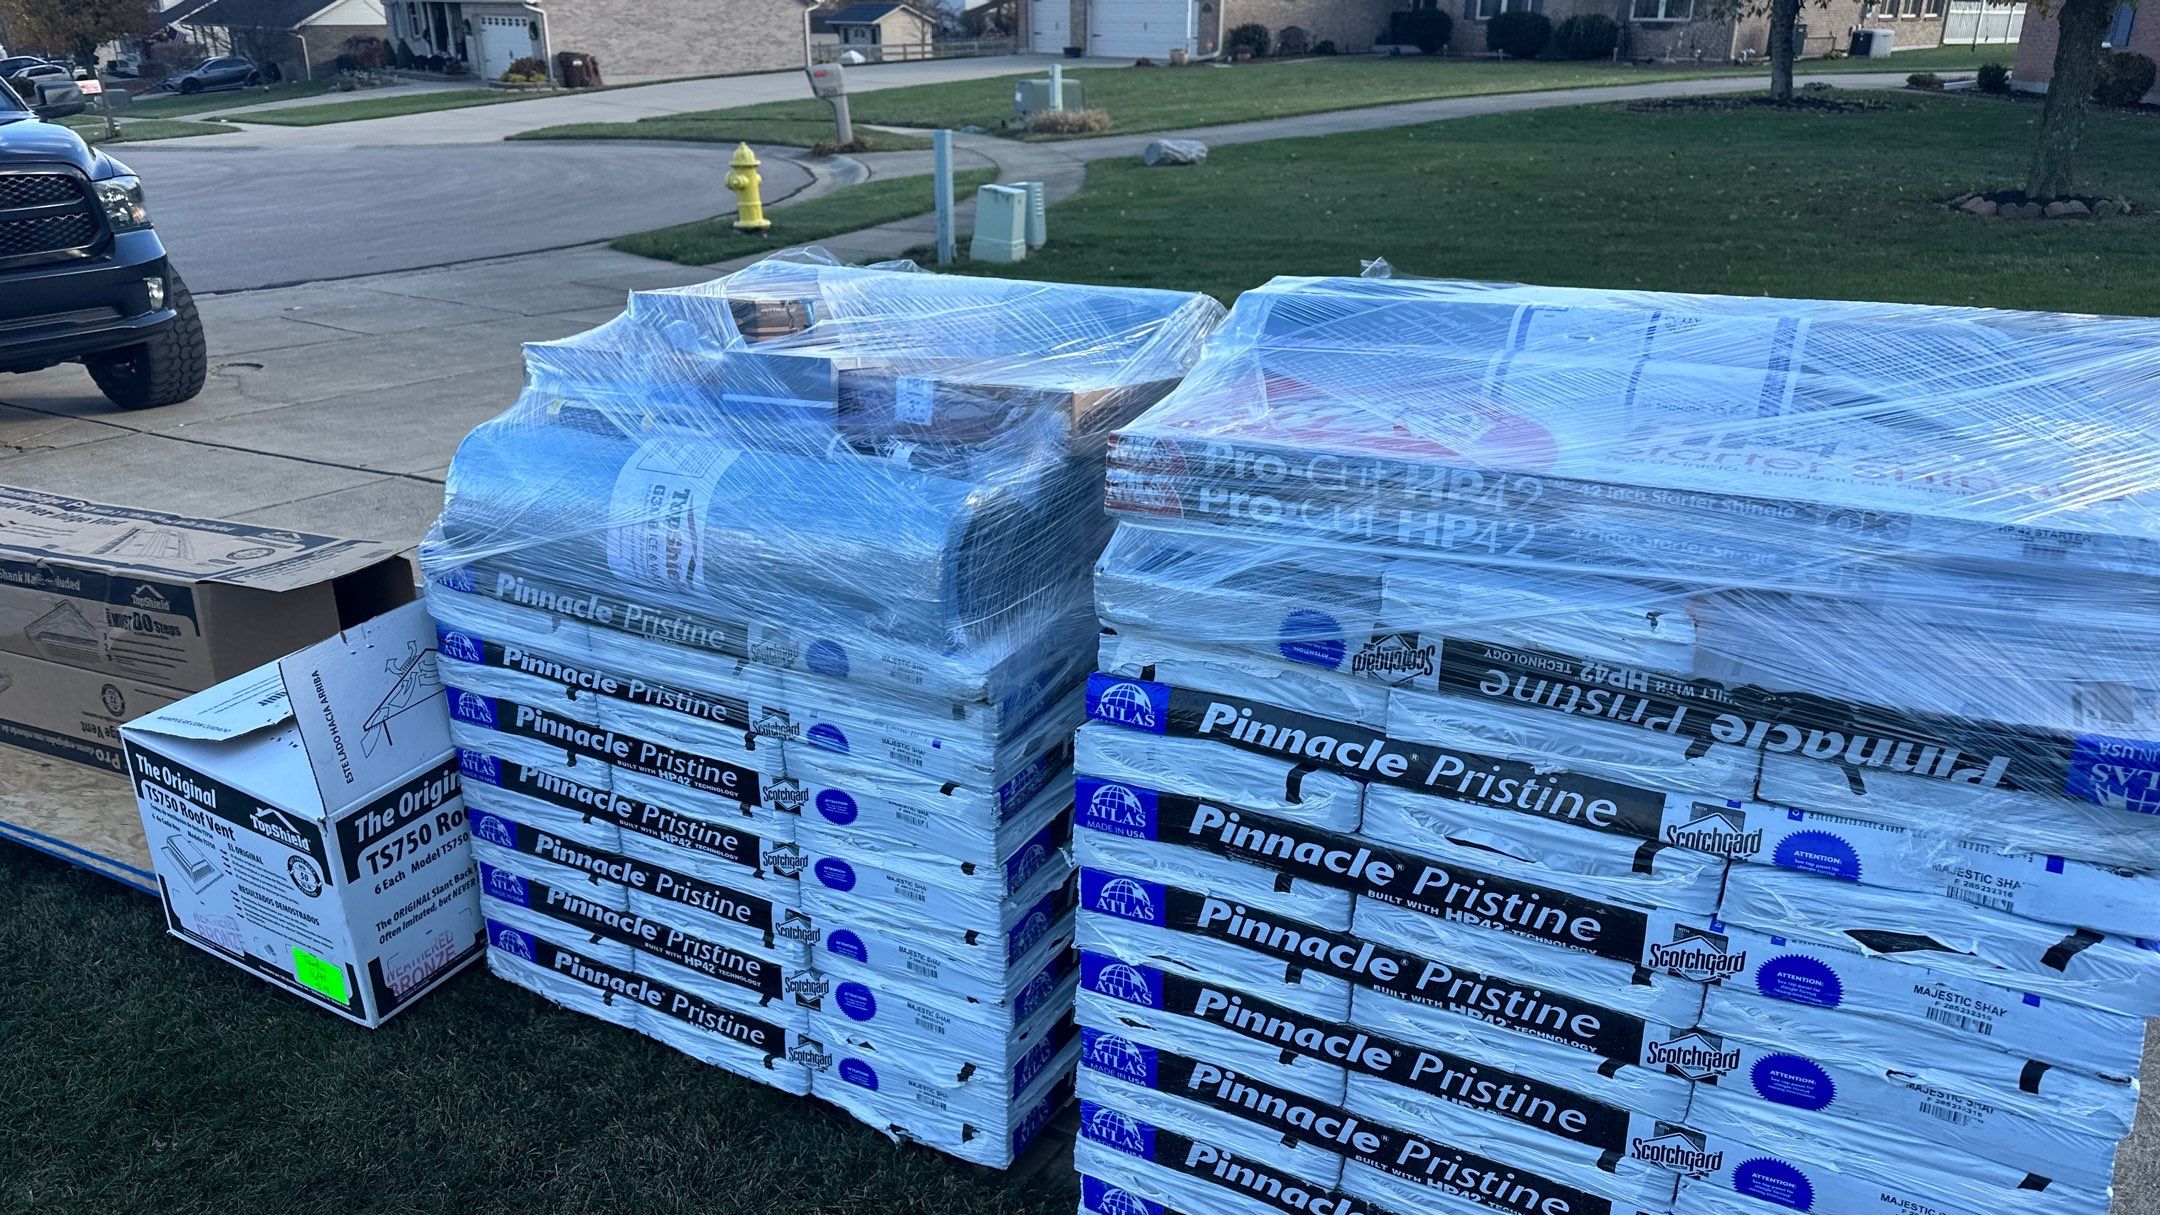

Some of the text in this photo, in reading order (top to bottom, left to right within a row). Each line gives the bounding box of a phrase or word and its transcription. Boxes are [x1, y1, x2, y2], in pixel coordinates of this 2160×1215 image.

[1402, 465, 1544, 512] HP42
[1722, 499, 1797, 520] Shingle
[1398, 511, 1537, 560] HP42
[2034, 529, 2092, 543] STARTER
[132, 610, 154, 634] DO
[153, 620, 182, 637] Steps
[496, 571, 726, 650] Pinnacle Pristine
[444, 644, 480, 662] ATLAS
[1352, 643, 1437, 677] Scotchgard
[1483, 648, 1572, 675] TECHNOLOGY
[503, 646, 728, 722] Pinnacle Pristine
[1578, 659, 1652, 694] HP42
[311, 669, 354, 785] ESTE LADO HACIA ARRIBA
[457, 706, 493, 724] ATLAS
[1094, 702, 1156, 728] ATLAS
[1479, 669, 2012, 788] Pristine Pinnacle
[80, 721, 102, 738] Vent
[752, 719, 801, 742] Scotchgard
[515, 704, 738, 788] Pinnacle Pristine
[881, 737, 911, 751] MAJESTIC
[2099, 741, 2135, 760] USA
[95, 750, 121, 770] Pro
[460, 759, 496, 777] ATLAS
[1199, 701, 1618, 827] Pinnacle Pristine
[135, 753, 217, 809] The Original
[617, 759, 739, 798] BUILT WITH HP42 TECHNOLOGY
[519, 765, 740, 851] Pinnacle Pristine
[762, 785, 810, 804] Scotchgard
[145, 785, 236, 842] TS750 Roof Vent
[354, 806, 395, 844] The
[1086, 802, 1147, 828] ATLAS
[250, 813, 312, 852] TopShield
[477, 829, 512, 847] ATLAS
[618, 819, 739, 861] BUILT WITH HP42 TECHNOLOGY
[1086, 820, 1147, 840] MADE IN USA
[1666, 824, 1763, 854] Scotchgard
[228, 843, 264, 866] EL ORIGINAL
[366, 823, 432, 876] TS750
[374, 831, 469, 895] 6 Each Model TS750
[762, 851, 809, 869] Scotchgard
[1793, 849, 1843, 865] ATTENTION:
[300, 872, 309, 882] 50
[534, 833, 752, 923] Pinnacle Pristine
[886, 874, 914, 888] MAJESTIC
[1188, 803, 1602, 941] Pinnacle Pristine
[1932, 864, 1992, 885] MAJESTIC
[375, 867, 473, 933] The ORIGINAL Slant Back
[489, 876, 525, 897] ATLAS
[238, 884, 275, 907] RESULTADOS
[274, 900, 321, 926] DEMOSTRADOS
[379, 877, 477, 945] Often Imitated, but NEVER
[1095, 897, 1155, 922] ATLAS
[546, 887, 762, 978] Pinnacle Pristine
[775, 922, 821, 943] Scotchgard
[1367, 888, 1598, 956] BUILT WITH HP42 TECHNOLOGY
[499, 941, 532, 961] ATLAS
[644, 941, 763, 988] BUILT WITH HP42 TECHNOLOGY
[898, 945, 926, 961] MAJESTIC
[1648, 943, 1747, 972] Scotchgard
[388, 943, 457, 998] BRONZE
[1196, 898, 1601, 1039] Pinnacle Pristine
[1776, 971, 1825, 987] ATTENTION:
[554, 949, 766, 1045] Pinnacle Pristine
[784, 975, 830, 995] Scotchgard
[1094, 980, 1154, 1007] ATLAS
[1913, 984, 1973, 1008] MAJESTIC
[907, 1001, 934, 1017] MAJESTIC
[1372, 983, 1598, 1054] BUILT WITH HP42 TECHNOLOGY
[788, 1046, 833, 1067] Scotchgard
[1091, 1052, 1148, 1079] ATLAS
[1193, 987, 1589, 1134] Pinnacle Pristine
[1646, 1041, 1741, 1071] Scotchgard
[1090, 1062, 1147, 1087] MADE IN USA
[1769, 1069, 1817, 1086] ATTENTION:
[1905, 1082, 1963, 1105] MAJESTIC
[1087, 1124, 1146, 1152] ATLAS
[1187, 1062, 1571, 1215] Pinnacle Pristine
[1631, 1137, 1724, 1171] Scotchgard
[1355, 1153, 1483, 1203] BUILT WITH HP42
[1751, 1171, 1798, 1190] ATTENTION:
[1880, 1192, 1937, 1215] MAJESTIC
